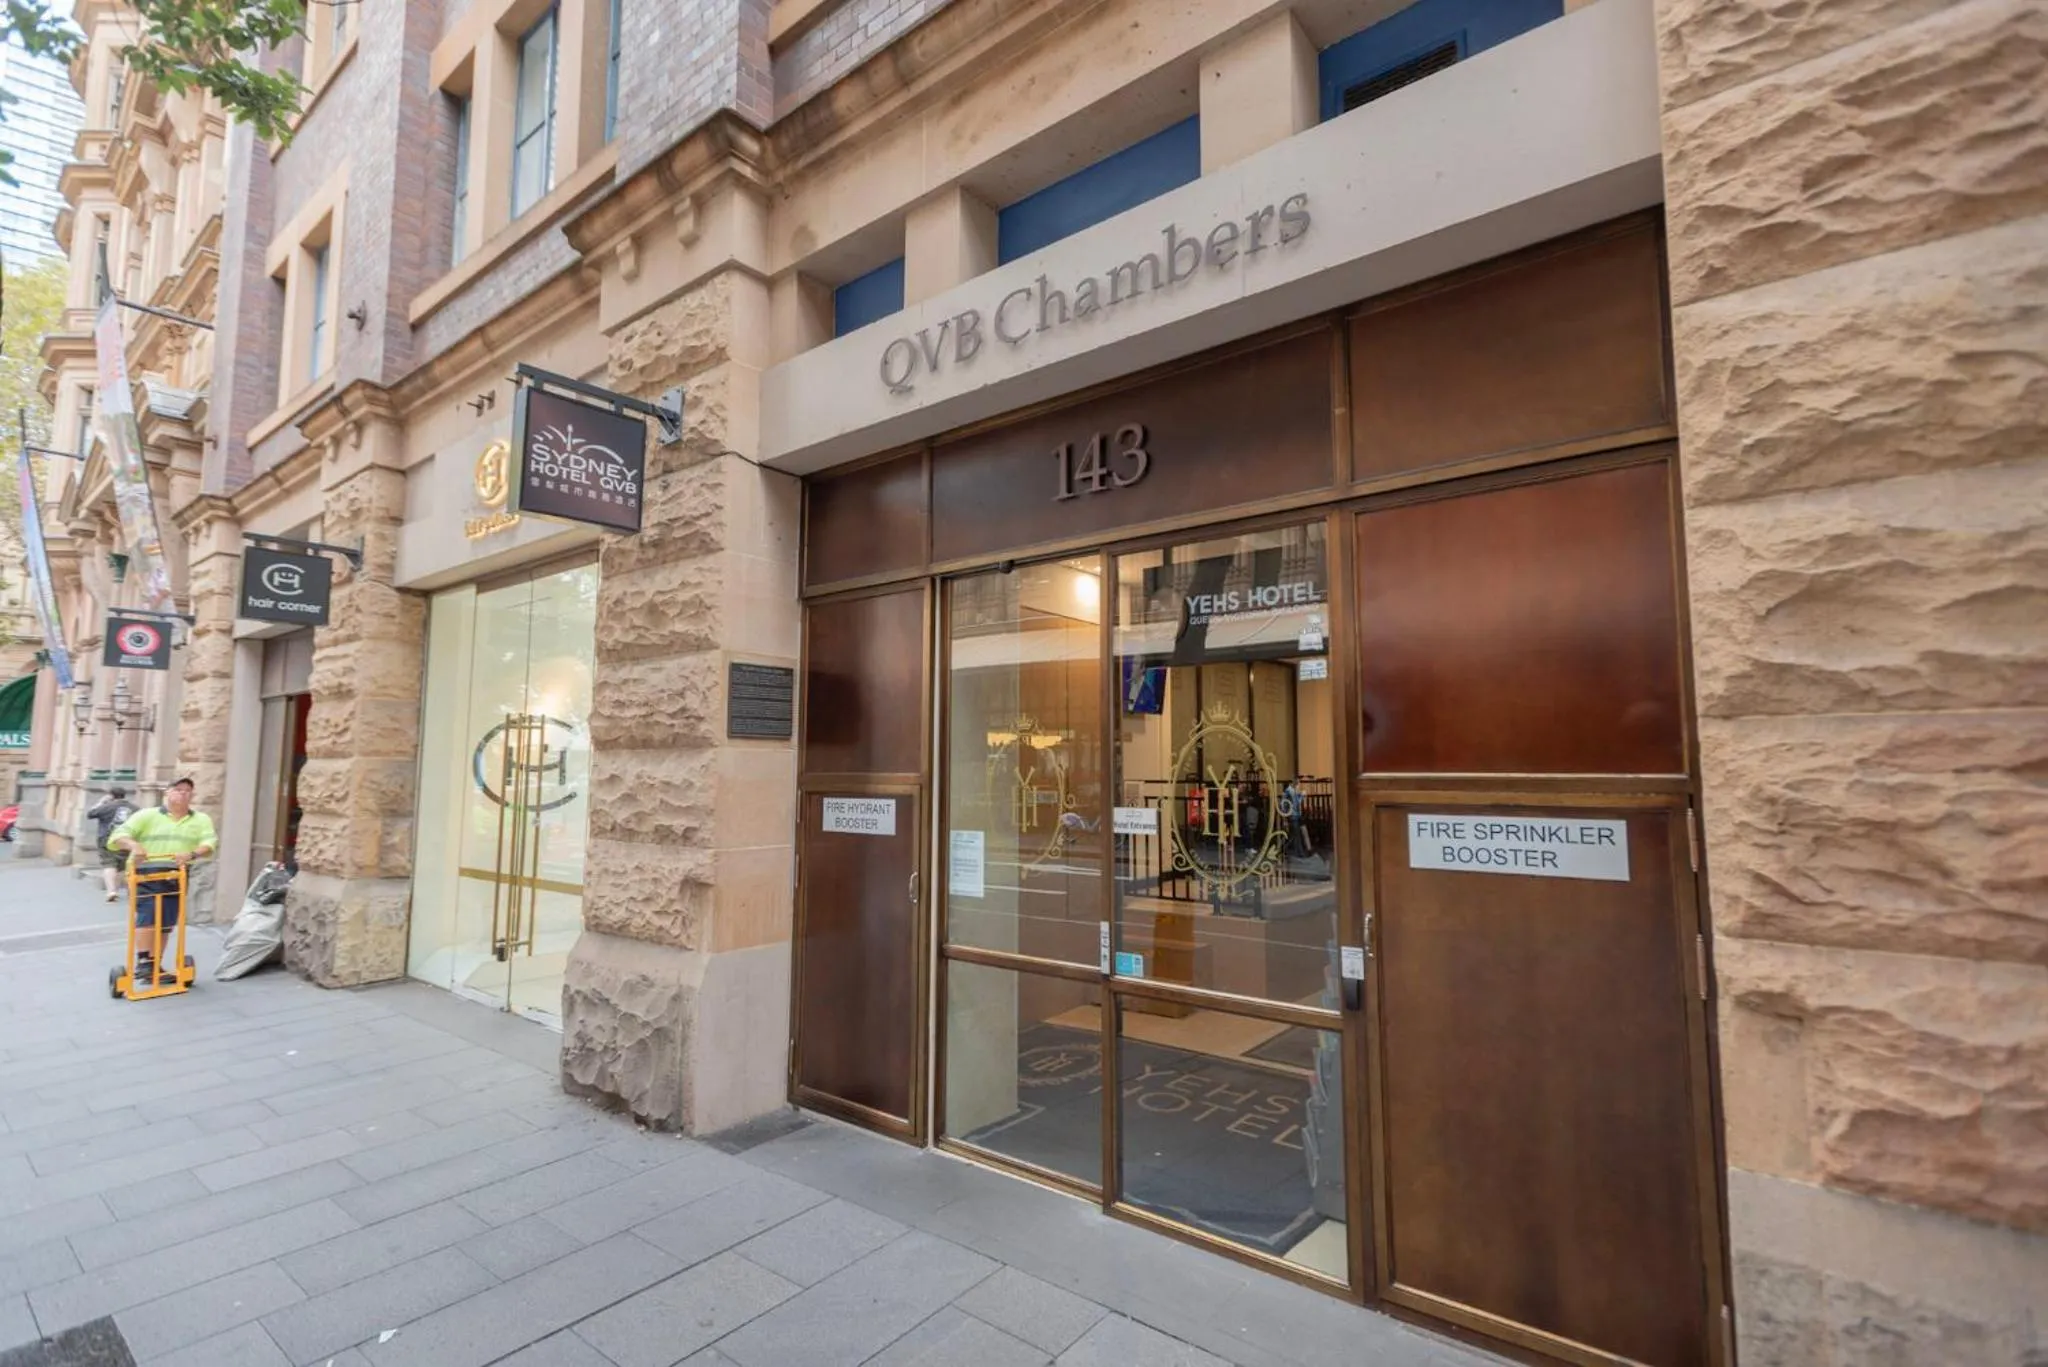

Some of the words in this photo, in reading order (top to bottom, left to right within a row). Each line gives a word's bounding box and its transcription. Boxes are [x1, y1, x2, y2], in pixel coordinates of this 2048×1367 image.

[880, 309, 981, 395] QVB
[994, 192, 1312, 345] Chambers
[531, 443, 638, 481] SYDNEY
[531, 460, 592, 485] HOTEL
[600, 476, 637, 494] QVB
[1051, 423, 1150, 500] 143
[248, 596, 276, 608] hair
[277, 602, 321, 613] corner
[1186, 591, 1240, 614] YEHS
[1248, 581, 1321, 607] HOTEL
[826, 801, 845, 813] FIRE
[847, 803, 891, 814] HYDRANT
[835, 817, 879, 829] BOOSTER
[1416, 821, 1465, 839] FIRE
[1474, 823, 1616, 846] SPRINKLER
[1442, 846, 1559, 868] BOOSTER
[1136, 1064, 1301, 1116] YEHS
